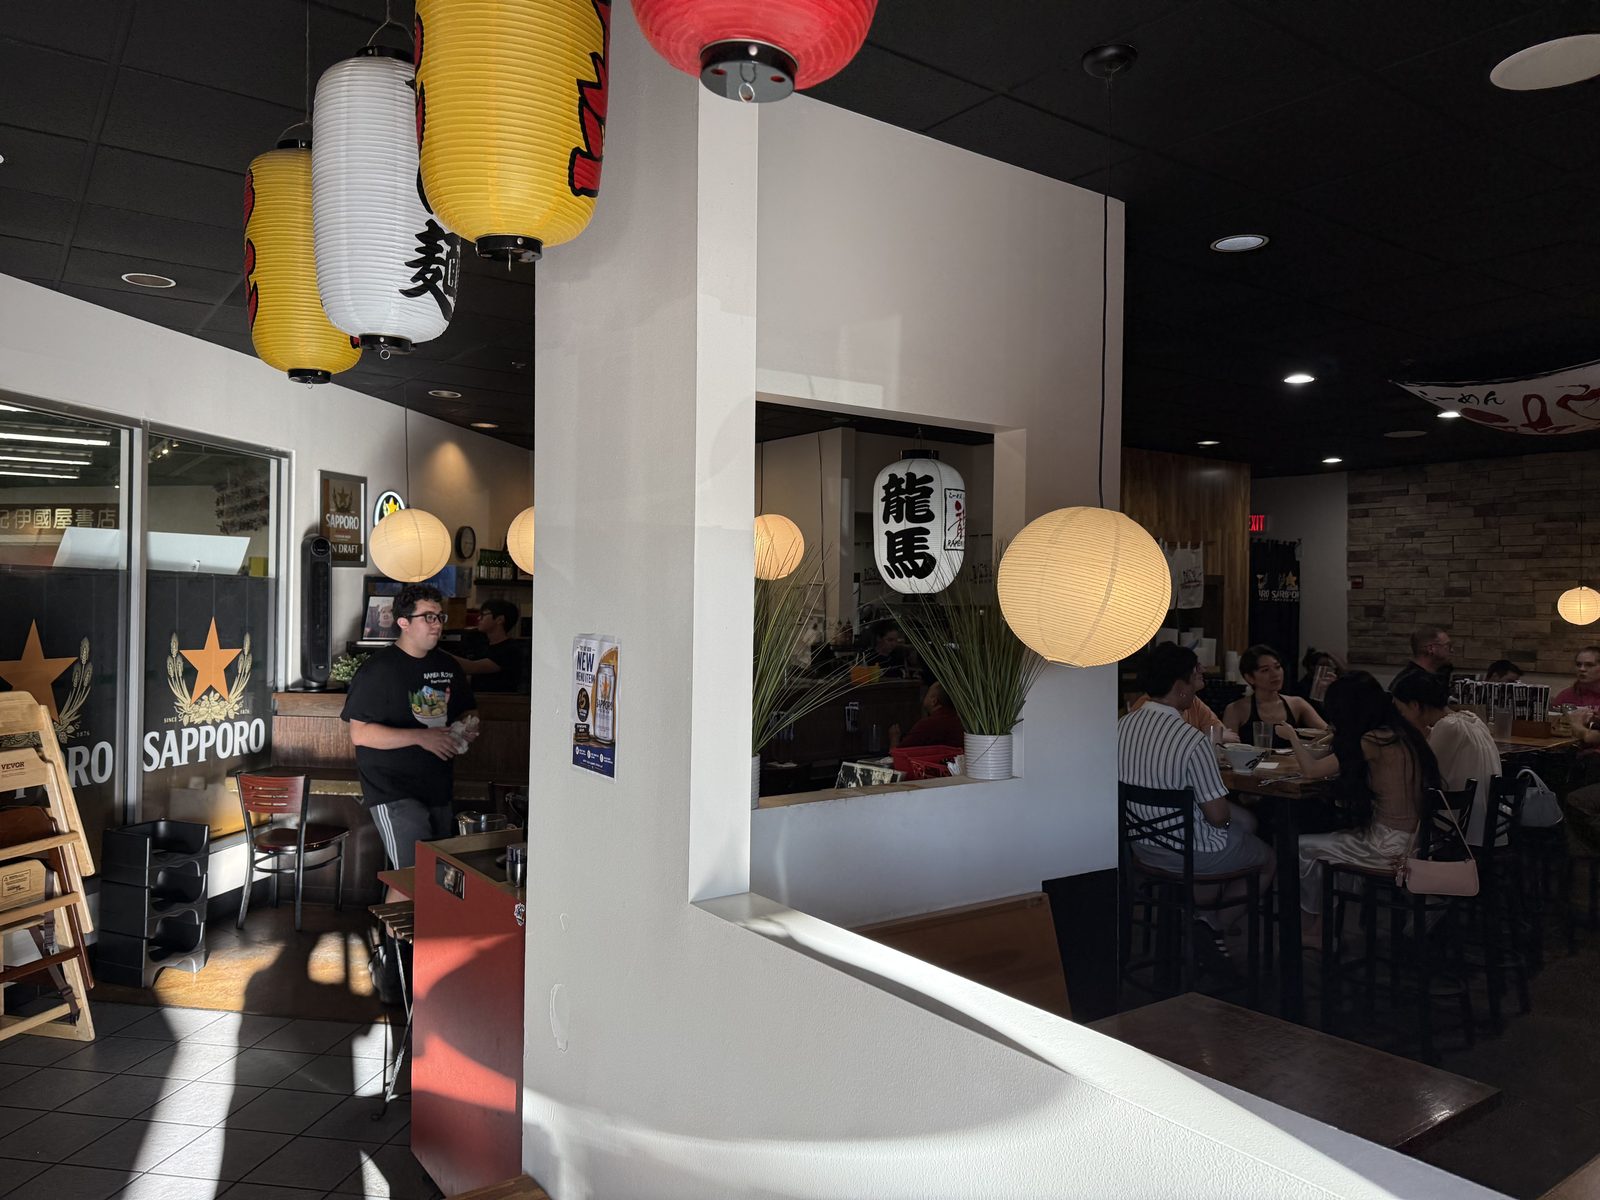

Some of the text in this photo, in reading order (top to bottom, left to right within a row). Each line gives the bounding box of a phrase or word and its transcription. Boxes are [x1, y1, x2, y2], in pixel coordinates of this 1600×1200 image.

[325, 513, 360, 530] SAPPORO
[881, 471, 936, 579] 龍馬
[338, 543, 359, 554] DRAFT
[576, 651, 595, 672] NEW
[143, 718, 265, 772] SAPPORO
[1, 761, 25, 770] VEVOR
